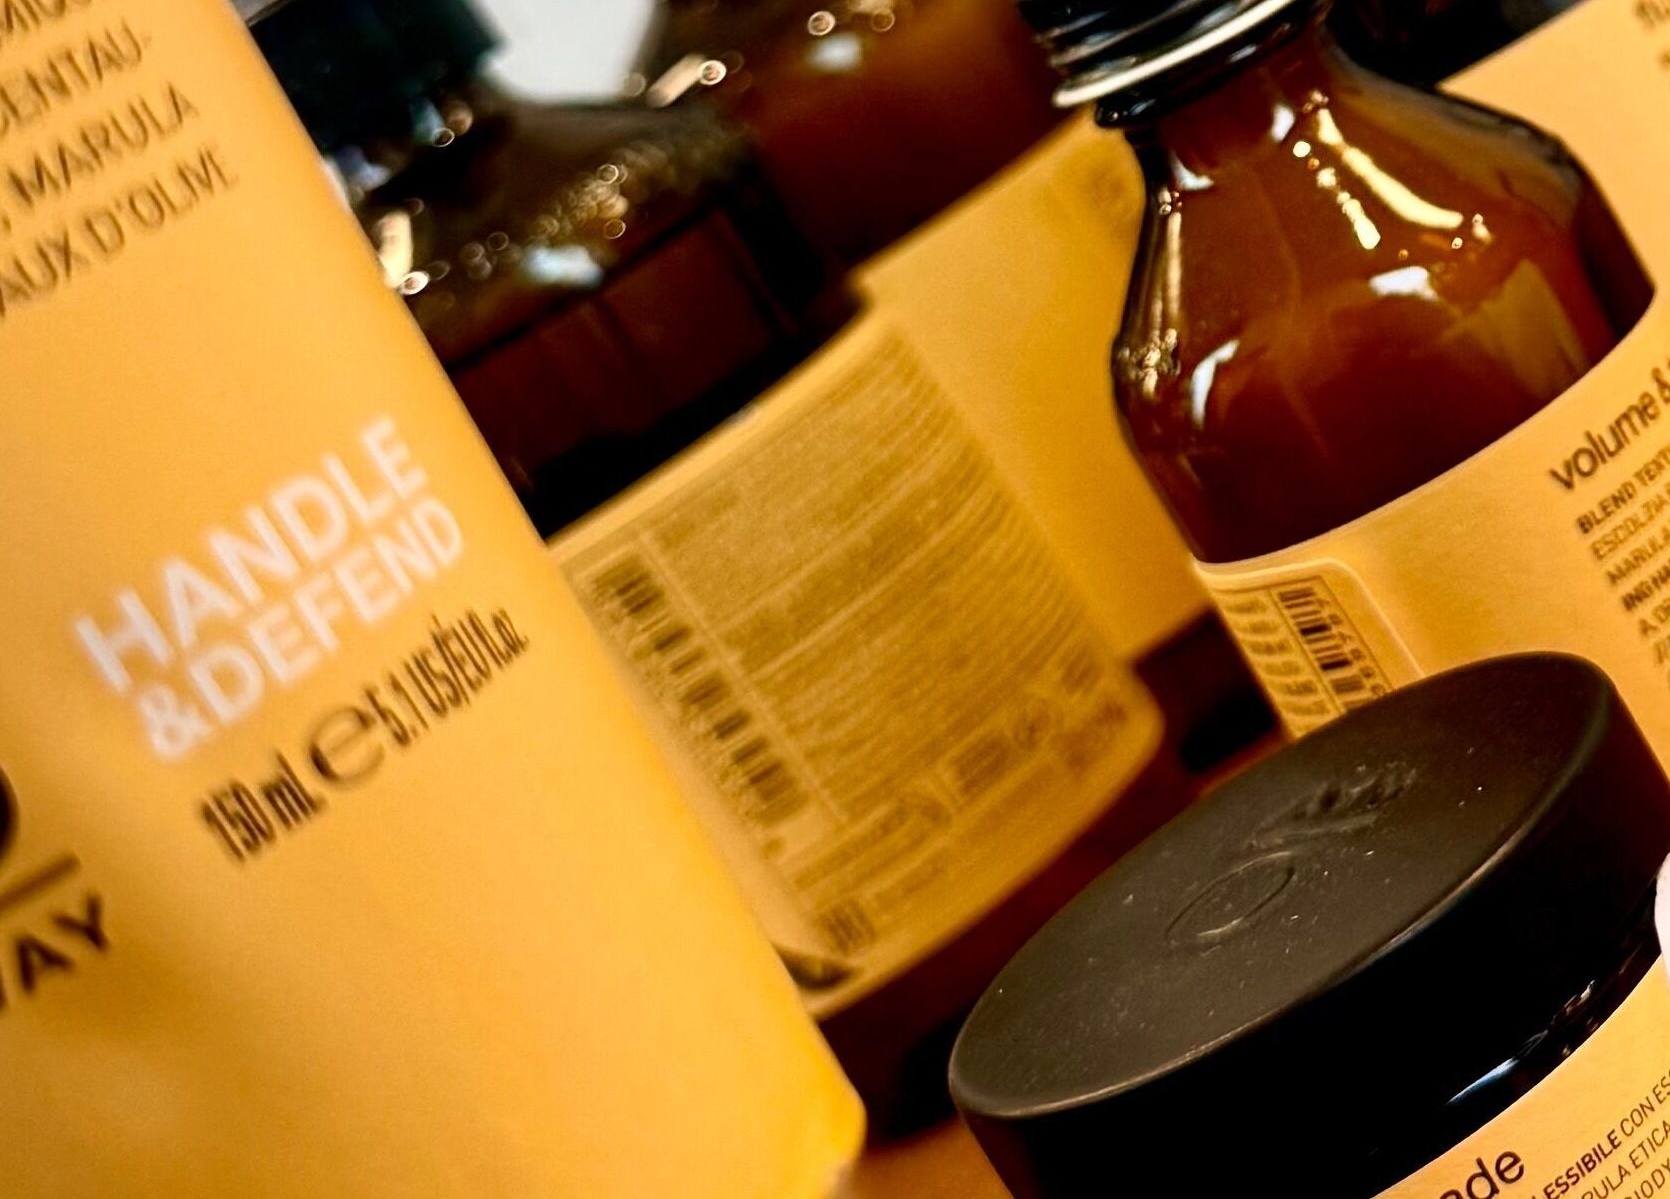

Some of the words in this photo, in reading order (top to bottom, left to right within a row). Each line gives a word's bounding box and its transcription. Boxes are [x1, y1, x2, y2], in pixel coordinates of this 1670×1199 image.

[0, 18, 152, 136] ENTAU-
[8, 80, 199, 208] MARULA
[1549, 391, 1661, 491] volume
[72, 414, 428, 693] HANDLE
[1577, 480, 1637, 534] BLEND
[201, 779, 276, 864] 150
[363, 670, 430, 747] 5.1
[0, 889, 110, 1010] AY
[1531, 1129, 1621, 1199] ESSIBILE
[1619, 1096, 1655, 1137] CON
